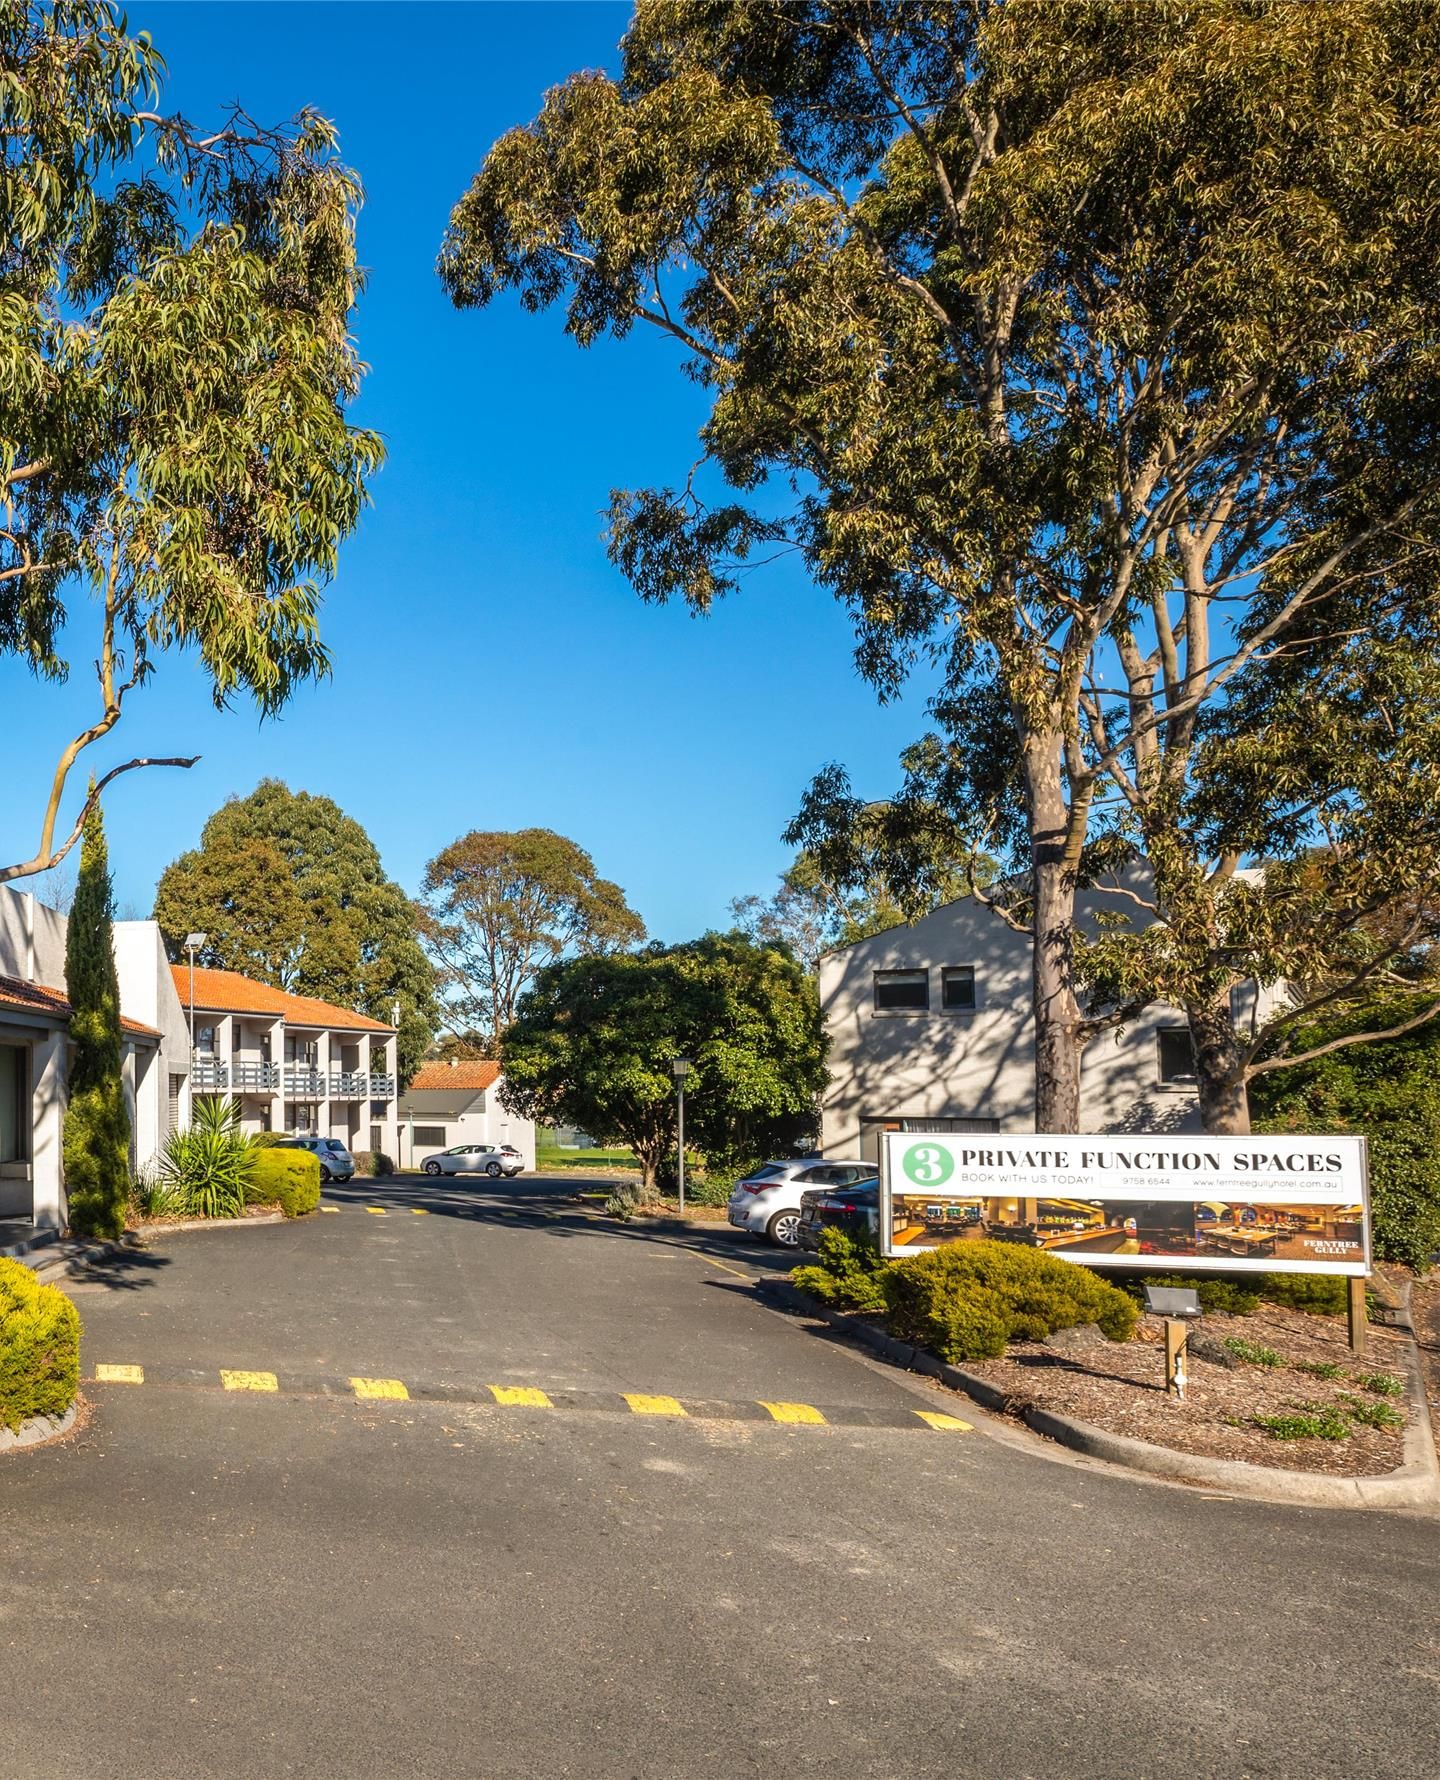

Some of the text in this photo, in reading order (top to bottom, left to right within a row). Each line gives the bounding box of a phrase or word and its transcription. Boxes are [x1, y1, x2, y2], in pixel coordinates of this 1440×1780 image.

[914, 1148, 943, 1181] 3
[961, 1150, 1343, 1172] PRIVATE FUNCTION SPACES
[961, 1172, 1094, 1185] BOOK WITH US TODAY!
[1122, 1176, 1146, 1186] 9758
[1303, 1239, 1359, 1249] FERNTREE
[1314, 1246, 1348, 1255] GULLY
